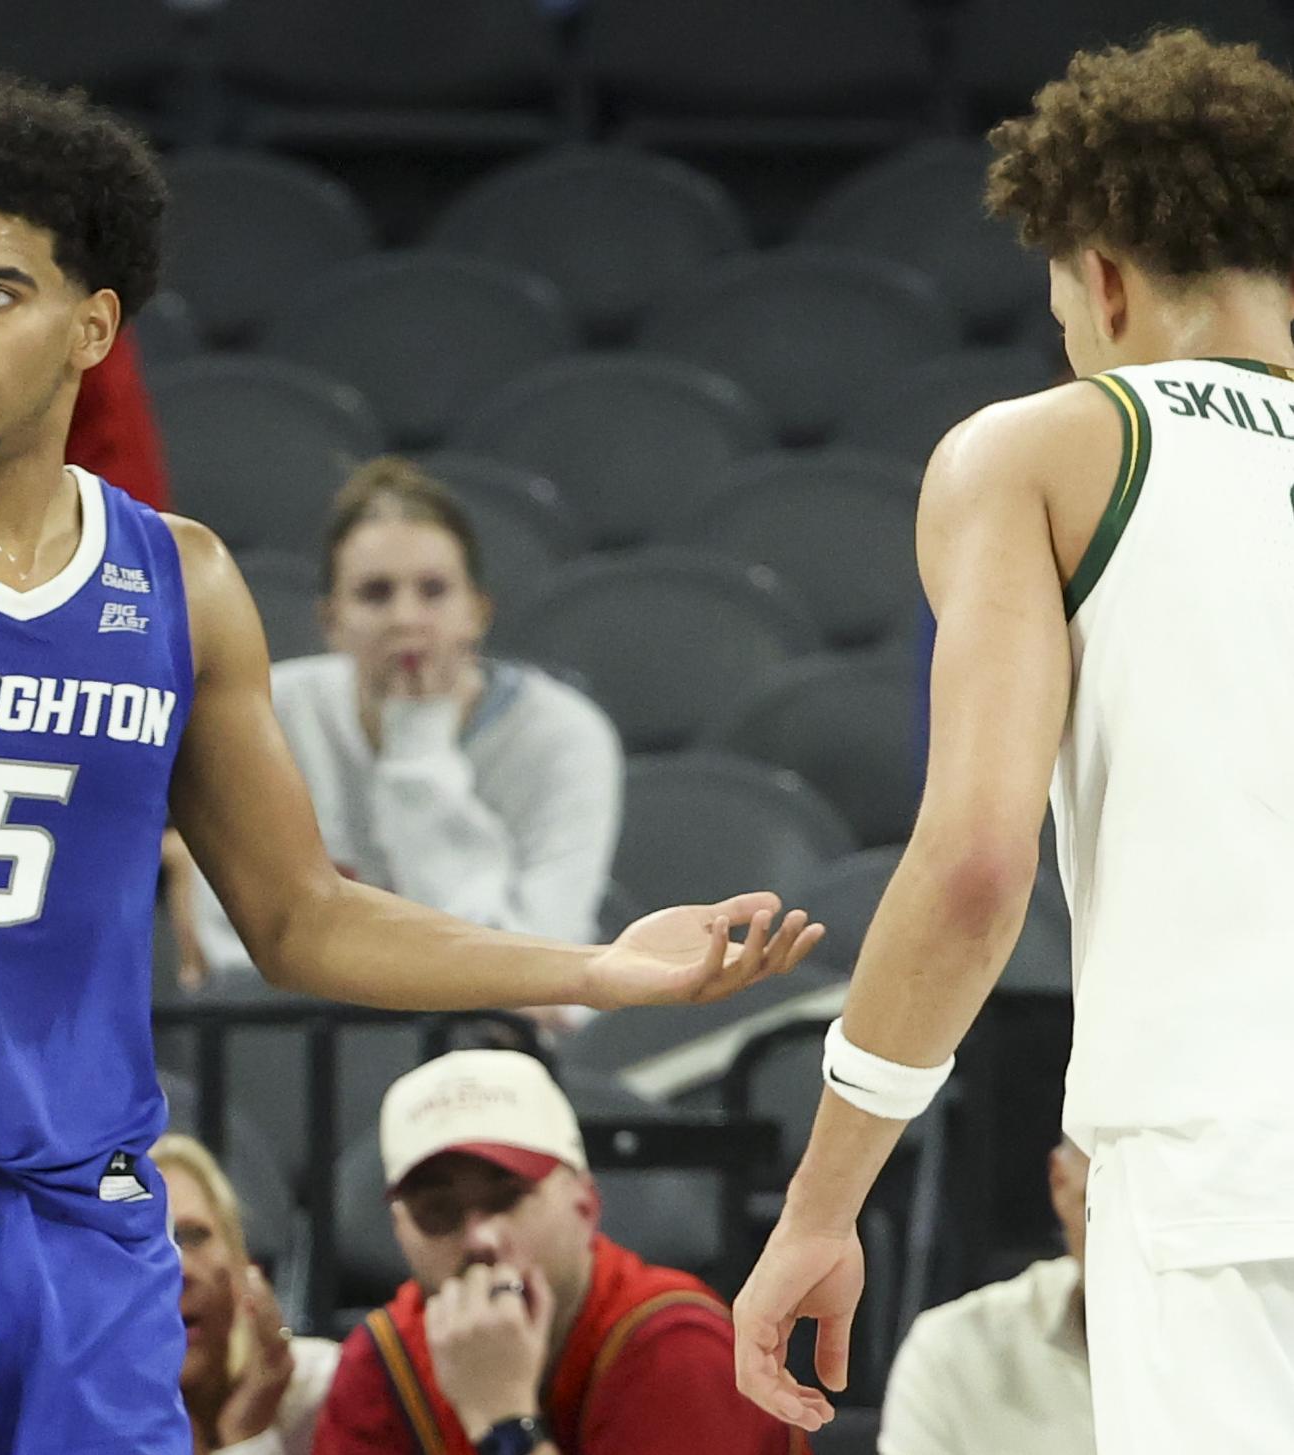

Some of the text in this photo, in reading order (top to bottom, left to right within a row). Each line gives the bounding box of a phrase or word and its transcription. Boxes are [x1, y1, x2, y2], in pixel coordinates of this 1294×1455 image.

[1154, 379, 1294, 440] SKILL
[119, 567, 145, 581] THE
[101, 574, 151, 593] CHANGE
[102, 602, 137, 616] BIG
[99, 614, 150, 630] EAST
